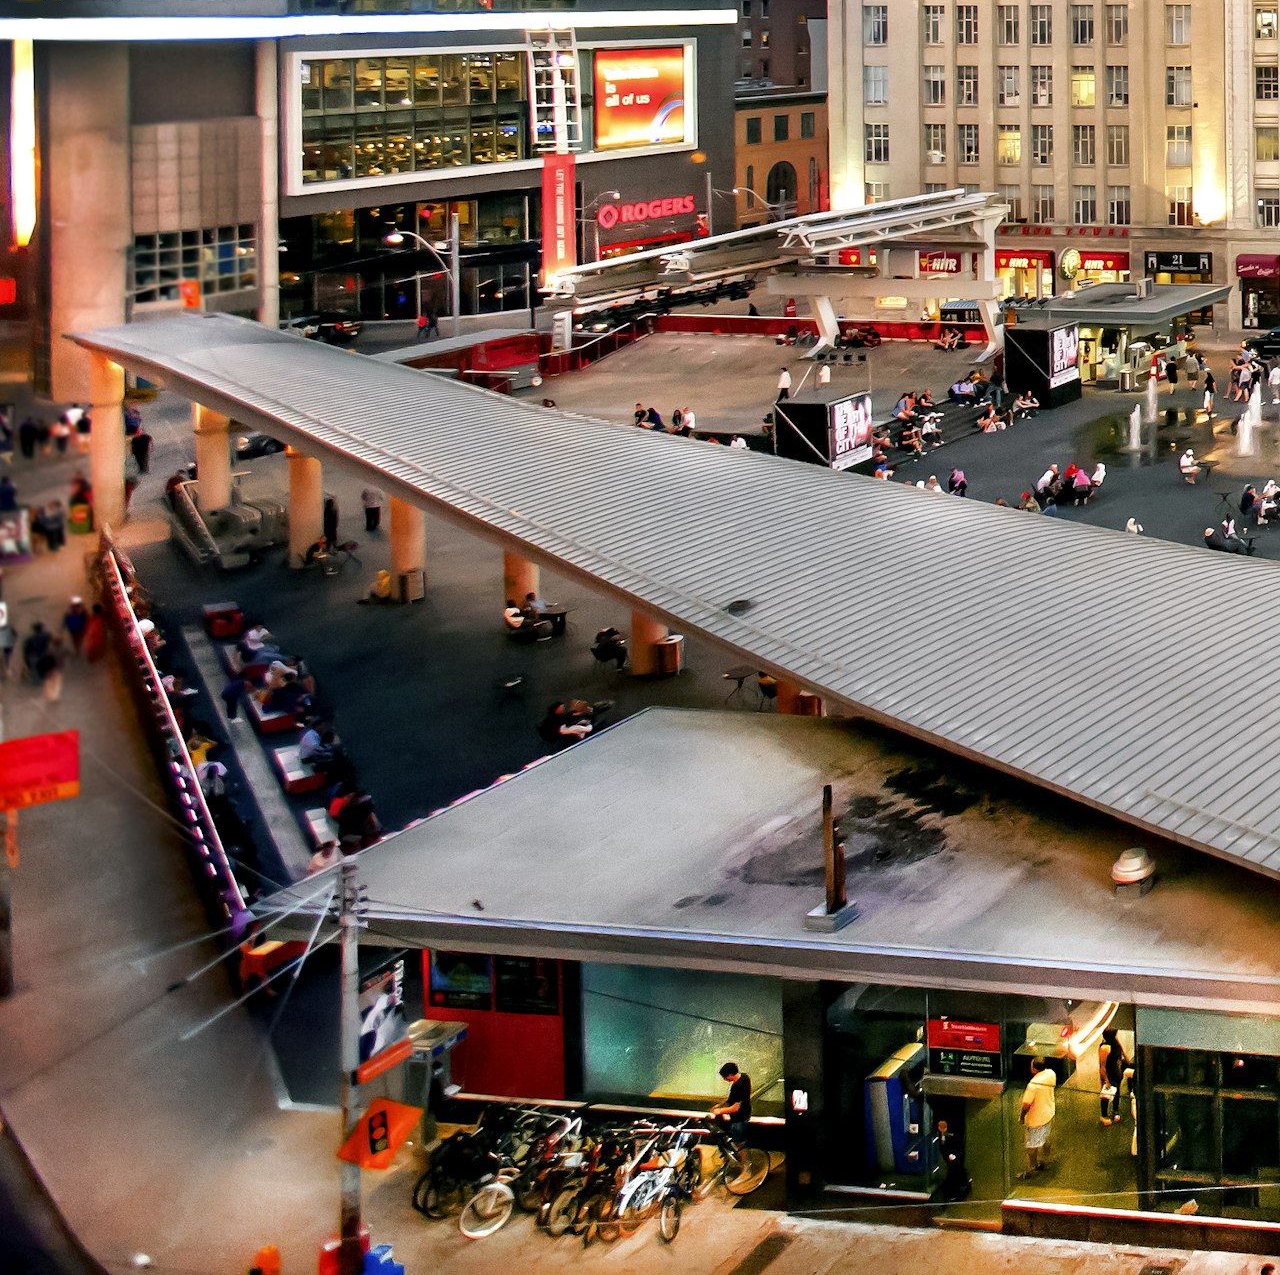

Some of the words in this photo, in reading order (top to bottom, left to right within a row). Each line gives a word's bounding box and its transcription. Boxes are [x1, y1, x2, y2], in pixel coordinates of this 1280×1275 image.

[605, 81, 616, 94] is
[605, 94, 620, 107] all
[622, 93, 634, 105] of
[636, 94, 650, 104] us
[621, 195, 695, 223] ROGERS
[1172, 254, 1183, 265] 21
